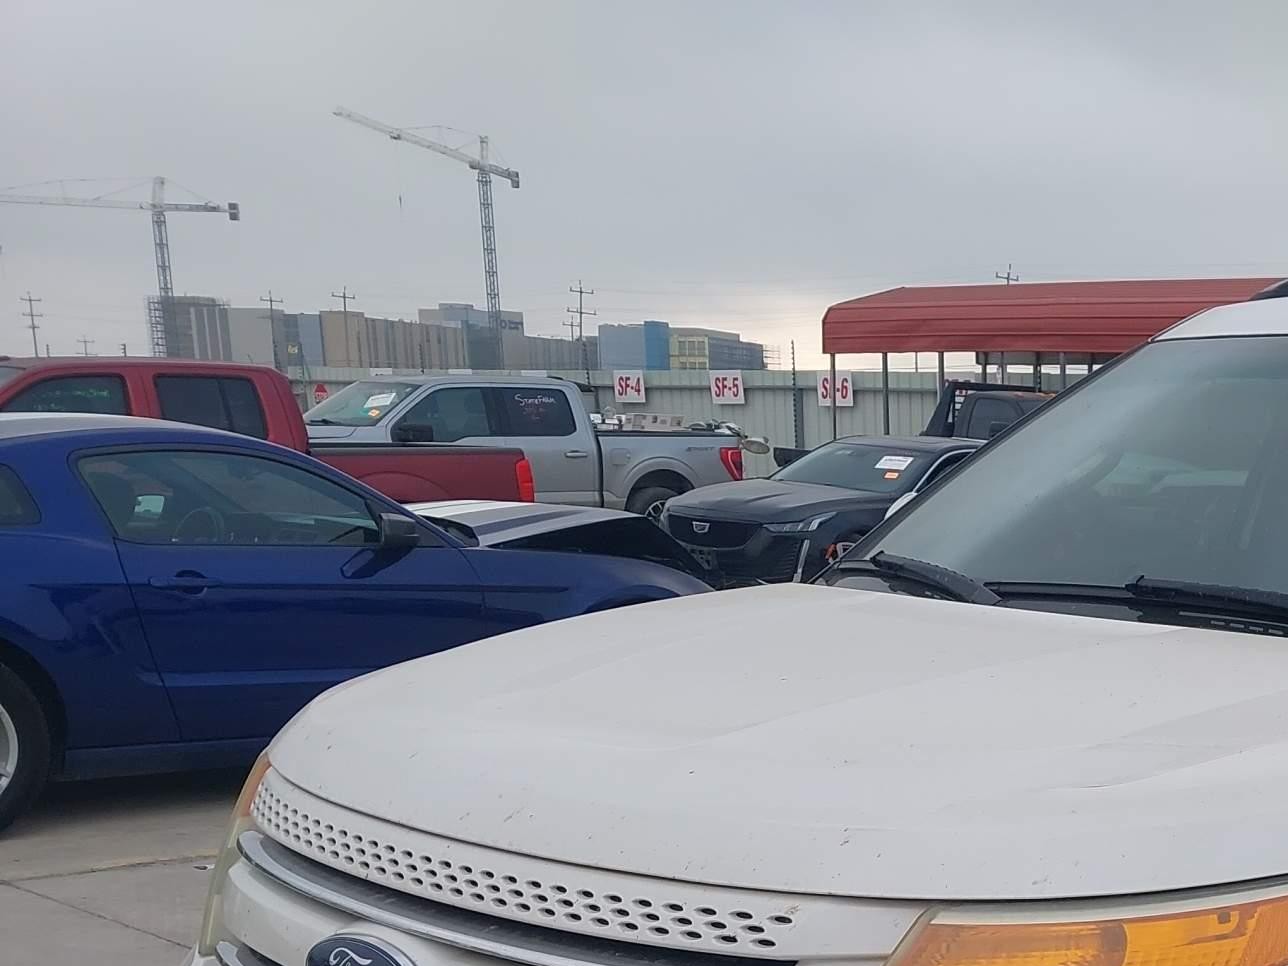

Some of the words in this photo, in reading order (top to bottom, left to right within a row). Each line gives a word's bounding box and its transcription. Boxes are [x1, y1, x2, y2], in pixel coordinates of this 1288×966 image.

[617, 376, 641, 396] SF-4
[715, 377, 739, 397] SF-5
[821, 377, 849, 399] S-6
